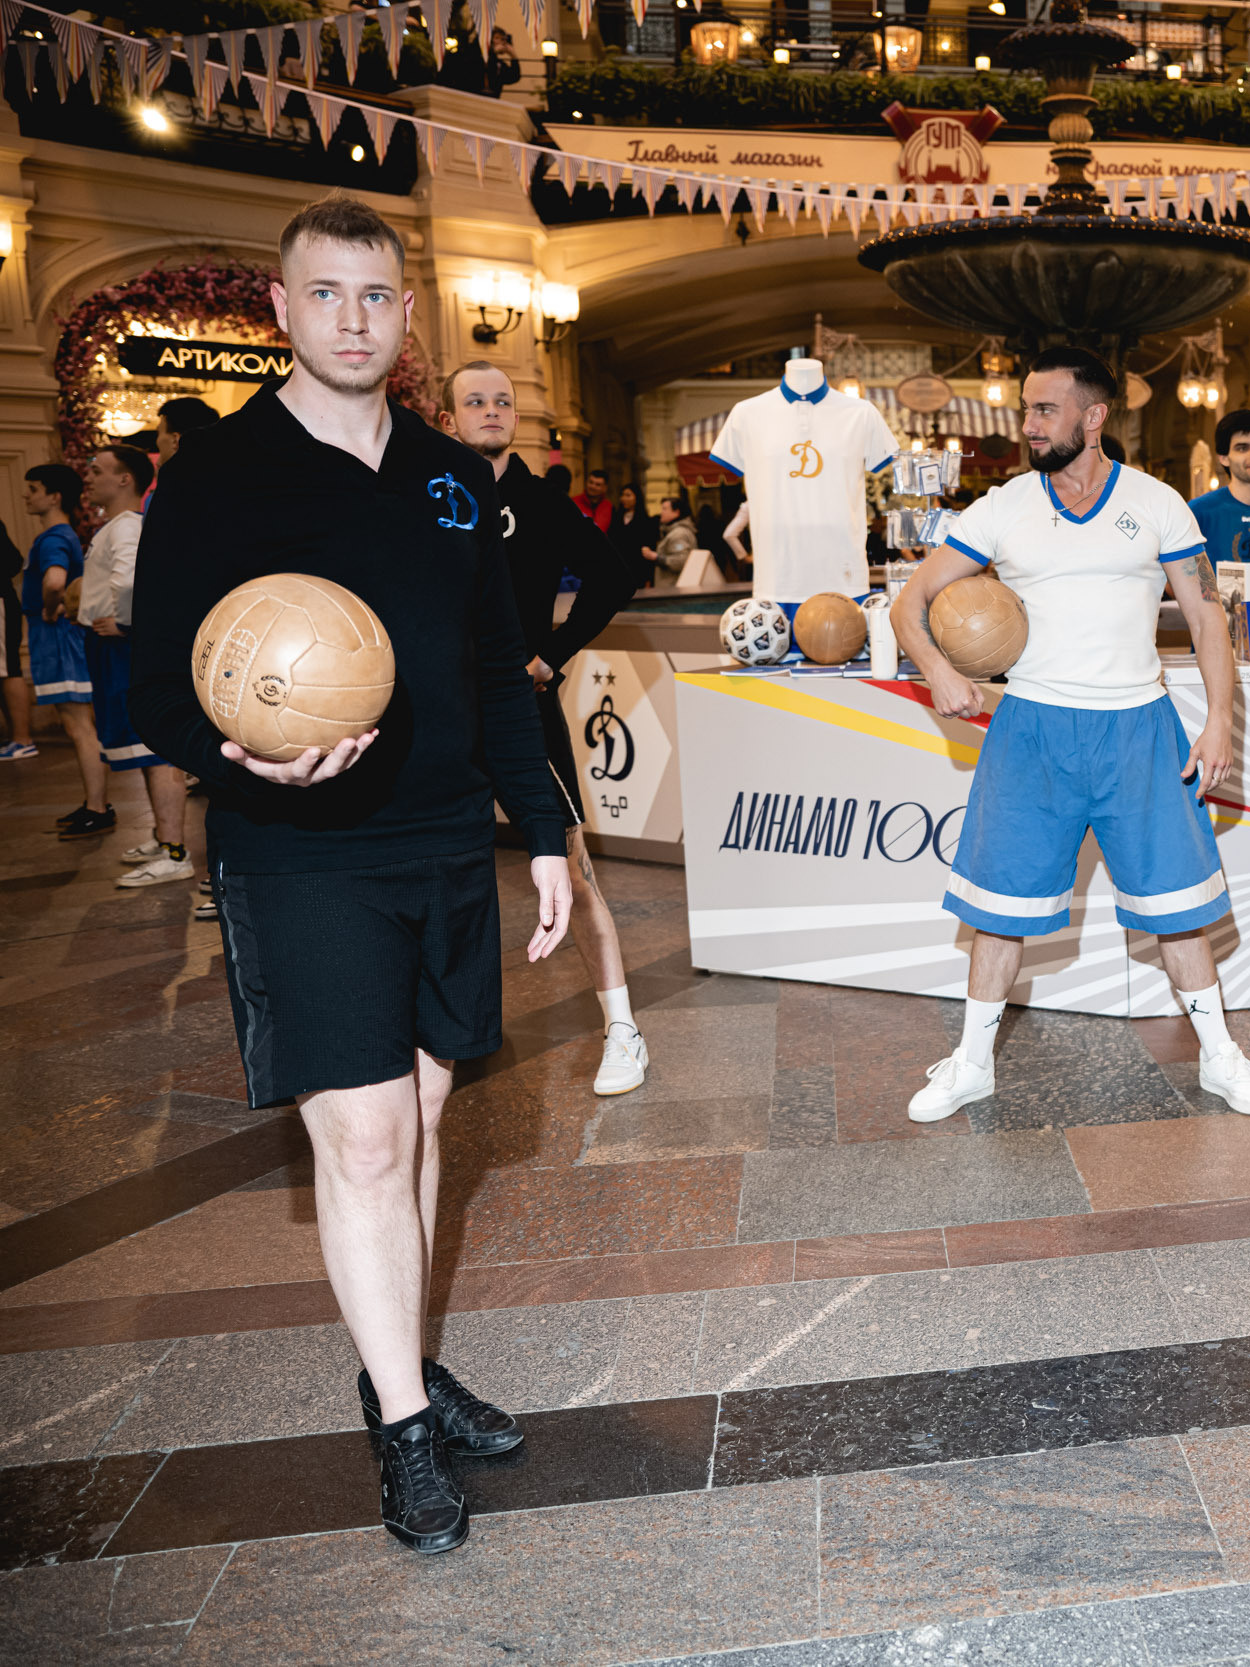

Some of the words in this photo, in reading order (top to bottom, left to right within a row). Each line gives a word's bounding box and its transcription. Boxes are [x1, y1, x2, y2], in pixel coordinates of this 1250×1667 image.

[926, 120, 963, 149] ГУМ
[626, 140, 720, 165] Главный
[730, 151, 824, 168] магазин
[718, 791, 859, 859] ДИНАМО
